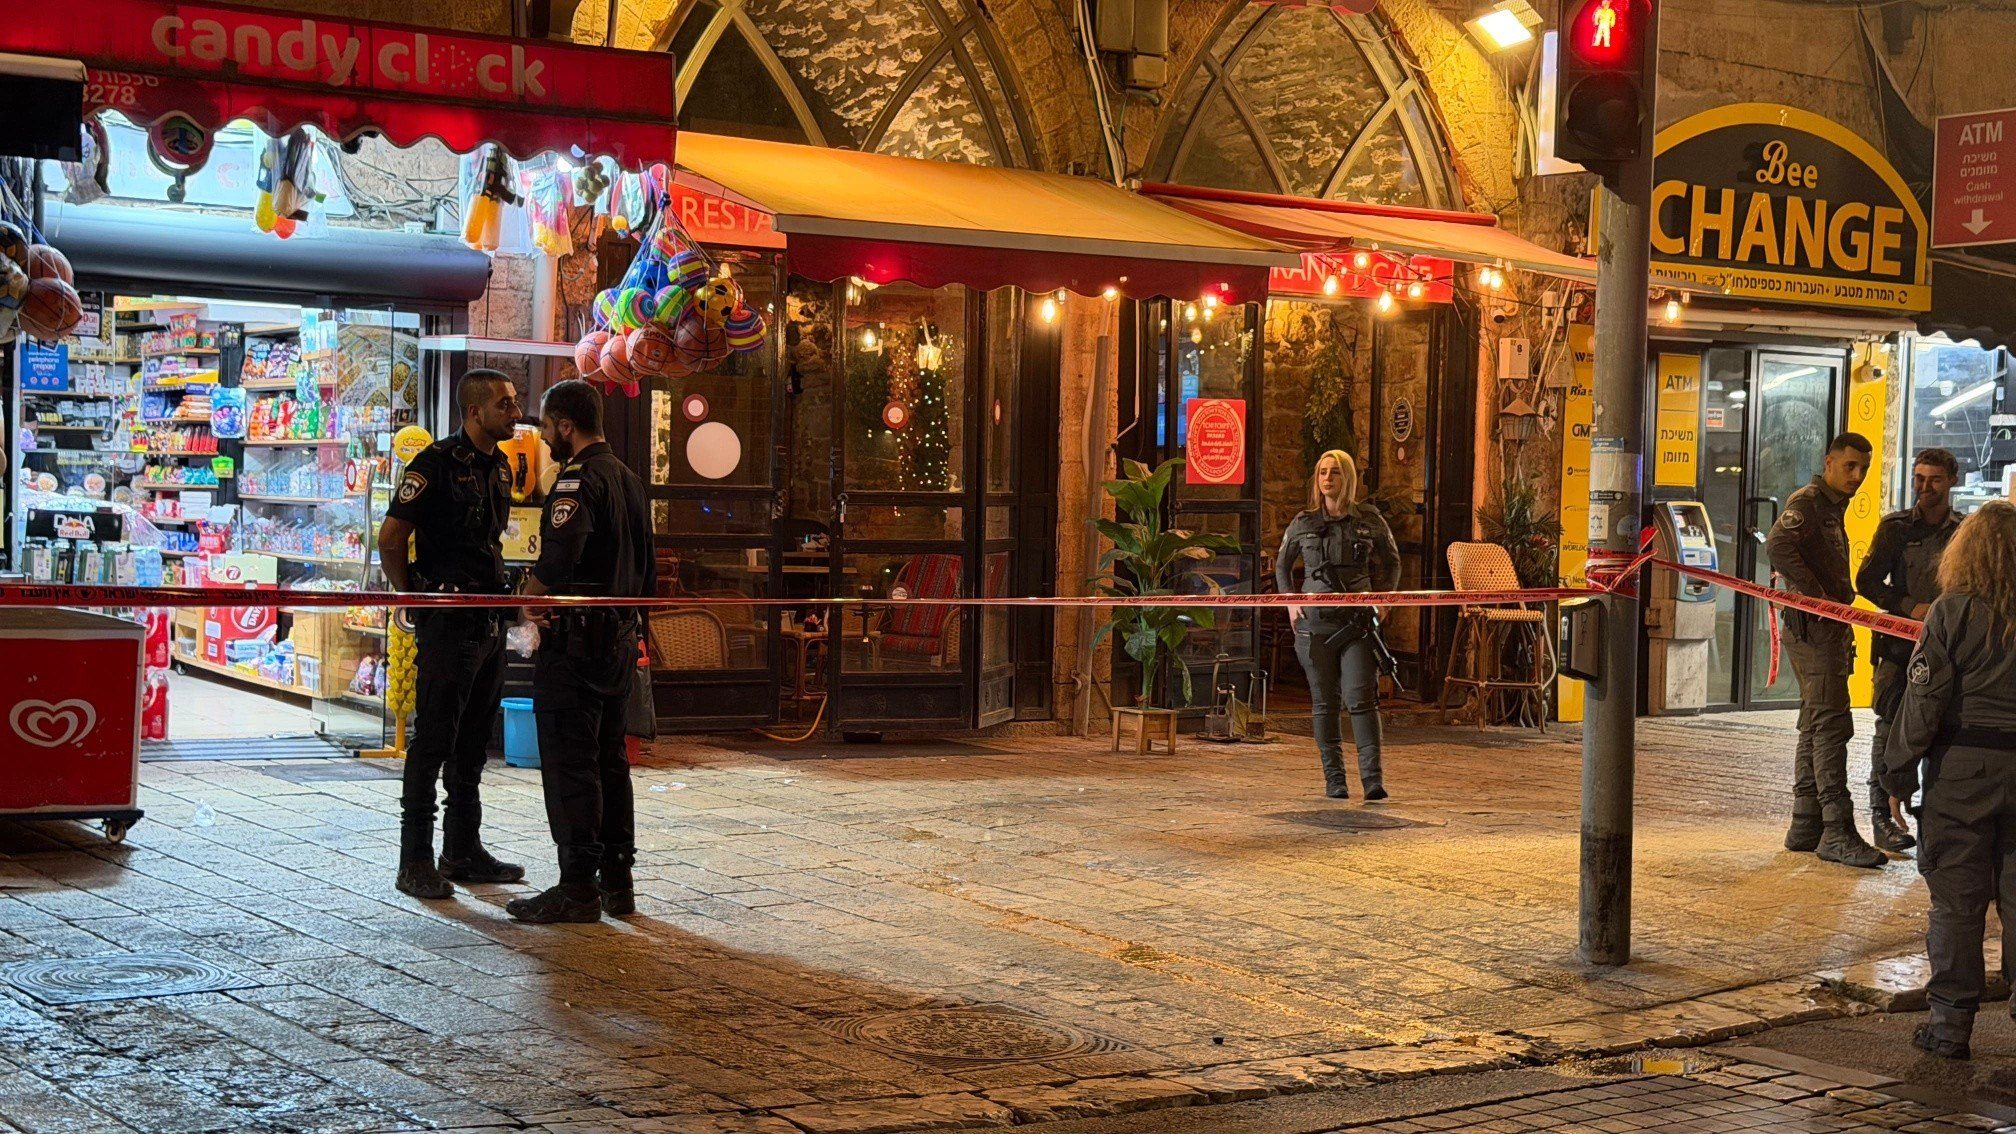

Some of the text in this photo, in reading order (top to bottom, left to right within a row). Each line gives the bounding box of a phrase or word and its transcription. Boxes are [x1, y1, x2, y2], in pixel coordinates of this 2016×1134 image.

[151, 15, 360, 86] candy
[1958, 120, 2003, 146] ATM
[1755, 139, 1818, 189] Bee
[1962, 151, 1997, 165] משיכת
[1960, 164, 1998, 178] מזומנים
[1966, 180, 1991, 192] Cash
[1953, 190, 2004, 205] withdrawal
[1650, 180, 1904, 276] CHANGE
[1785, 280, 1824, 296] העברות
[1833, 284, 1863, 300] מטבע
[1865, 287, 1895, 302] המרת
[1665, 374, 1693, 391] ATM
[1572, 422, 1594, 437] GM
[1660, 428, 1694, 442] משיכת
[1662, 450, 1690, 464] מזומן
